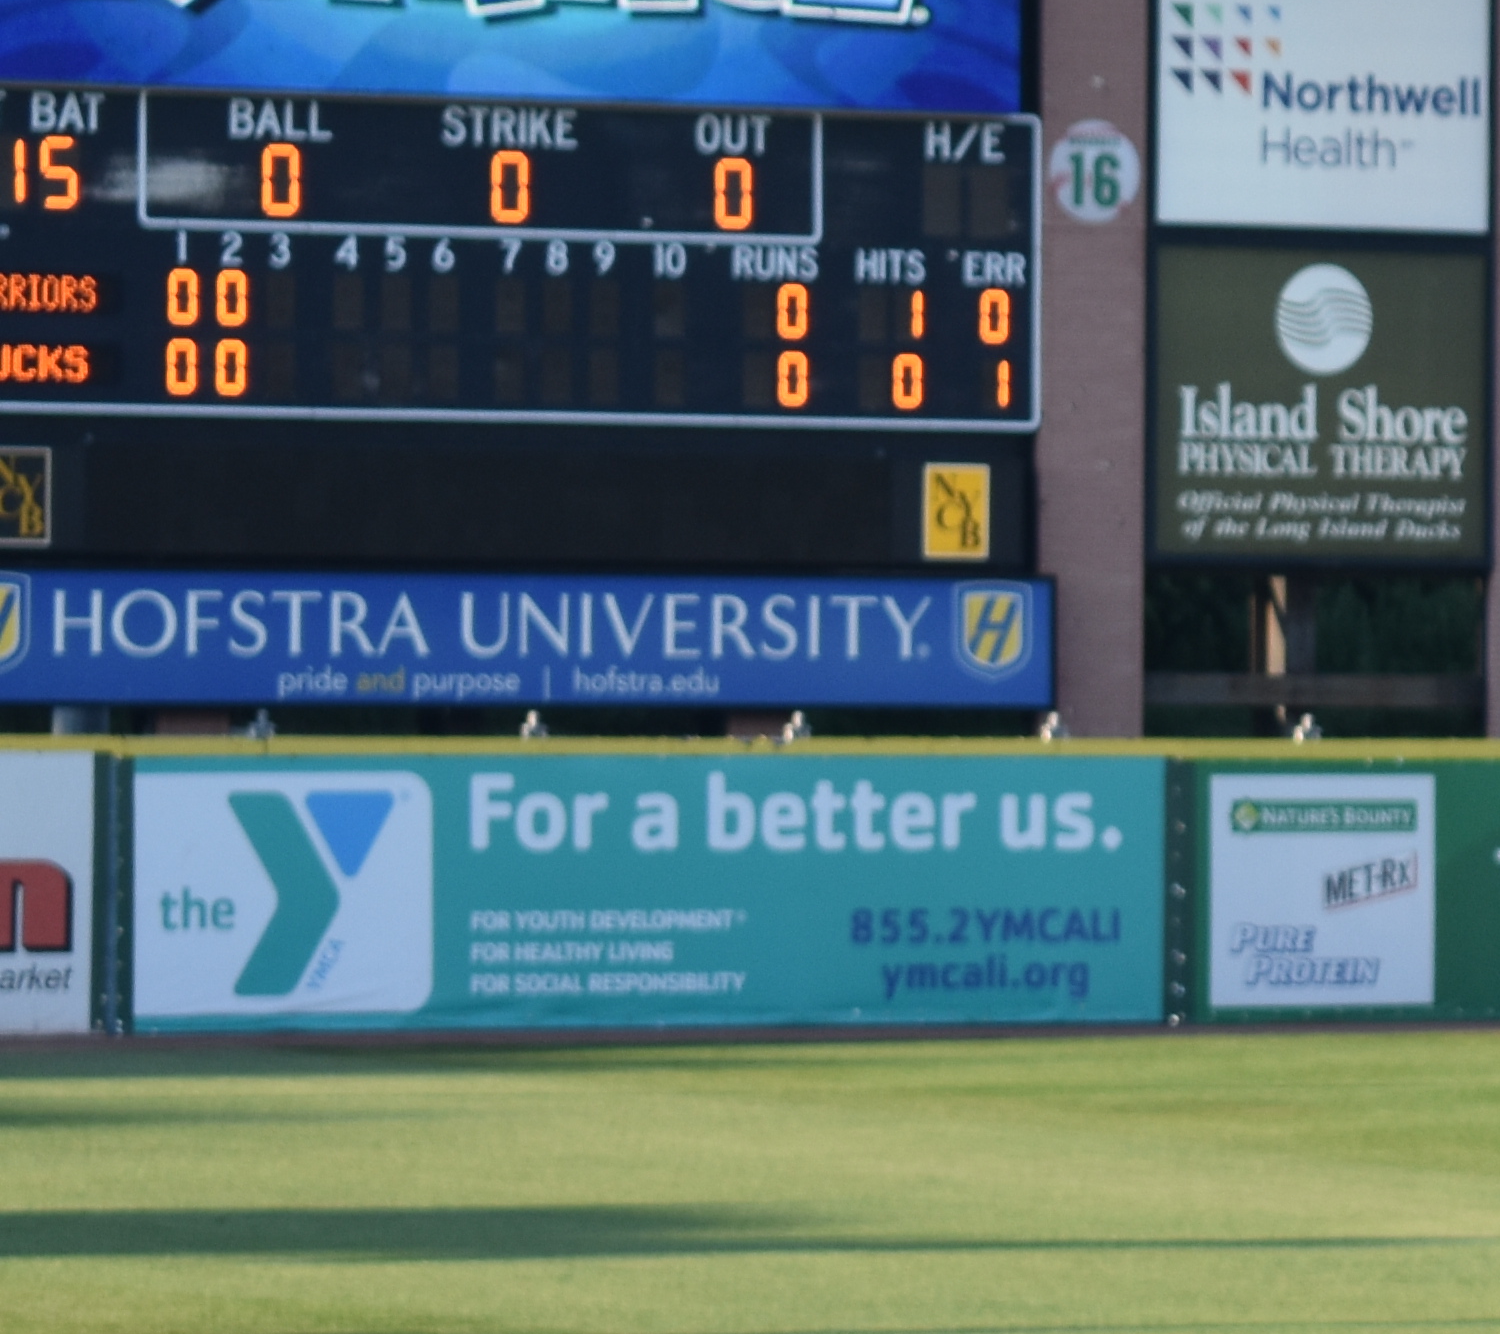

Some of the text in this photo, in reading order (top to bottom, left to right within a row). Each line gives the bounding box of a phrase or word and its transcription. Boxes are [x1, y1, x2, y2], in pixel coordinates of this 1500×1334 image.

[1260, 71, 1483, 120] Northwell
[30, 91, 1005, 163] BAT BALL STRIKE OUT H/E
[1259, 125, 1397, 171] Health
[13, 135, 753, 230] 15 0 0 0
[1068, 152, 1121, 209] 16
[175, 230, 1027, 287] 1 2 3 4 5 6 7 8 9 10 RUNS HITS ERR
[166, 267, 200, 328] 0
[215, 268, 250, 329] 0
[776, 281, 810, 342] 0
[977, 287, 1012, 347] 0
[164, 336, 199, 398] 0
[214, 337, 249, 399] 0
[776, 348, 810, 409] 0
[891, 351, 926, 411] 0
[1178, 381, 1469, 445] Island Shore
[1177, 441, 1469, 482] PHYSICAL THERAPY
[1267, 491, 1361, 518] Physical
[1363, 492, 1467, 521] Therapist
[1211, 516, 1251, 539] the
[1253, 517, 1312, 545] Long
[1316, 517, 1389, 540] Island
[1392, 519, 1463, 542] Ducks
[53, 587, 932, 662] HOFSTRA UNIVERSITY
[276, 663, 522, 700] pride and purpose
[571, 665, 721, 695] hofstra.edu
[468, 769, 1124, 854] For a better us.
[160, 886, 237, 932] the
[469, 909, 511, 932] FOR
[513, 909, 586, 933] YOUTH
[851, 906, 1122, 946] 855.2YMCALI
[469, 940, 675, 964] FOR HEALTHY LIVING
[1244, 954, 1381, 989] PROTEIN
[469, 971, 747, 996] FOR SOCIAL RESPONSIBILITY
[881, 952, 1091, 1001] ymcali.org
